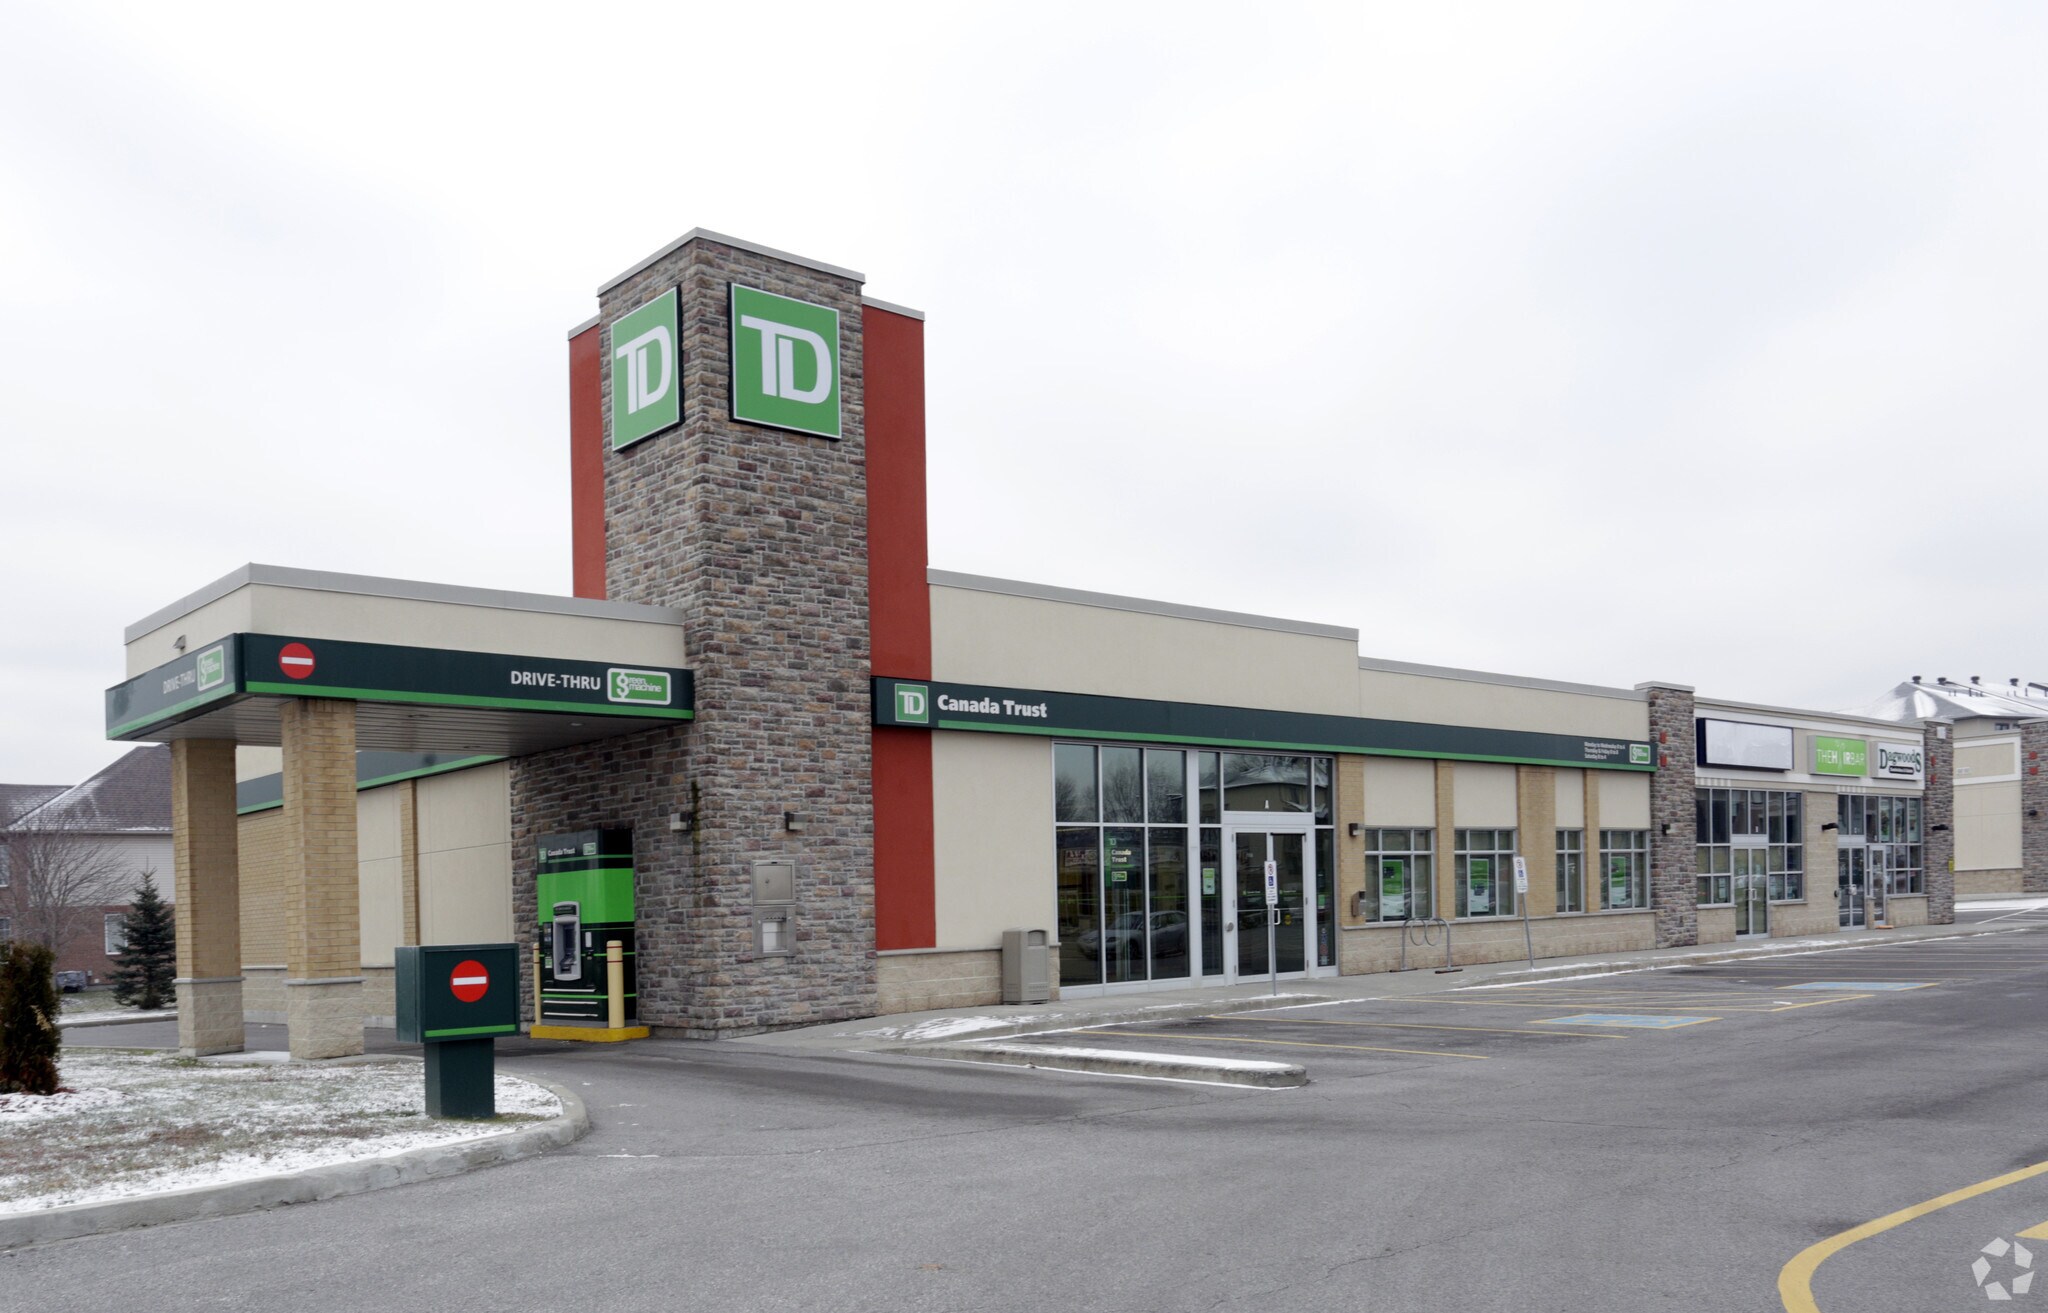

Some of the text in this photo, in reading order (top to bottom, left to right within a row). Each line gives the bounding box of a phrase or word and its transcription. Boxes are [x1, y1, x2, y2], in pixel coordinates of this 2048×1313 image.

[616, 325, 672, 415] TD
[741, 314, 832, 404] TD
[510, 670, 601, 690] DRIVE-THRU
[629, 682, 662, 693] machine
[898, 691, 925, 715] TD
[937, 694, 1048, 718] Canada Trust
